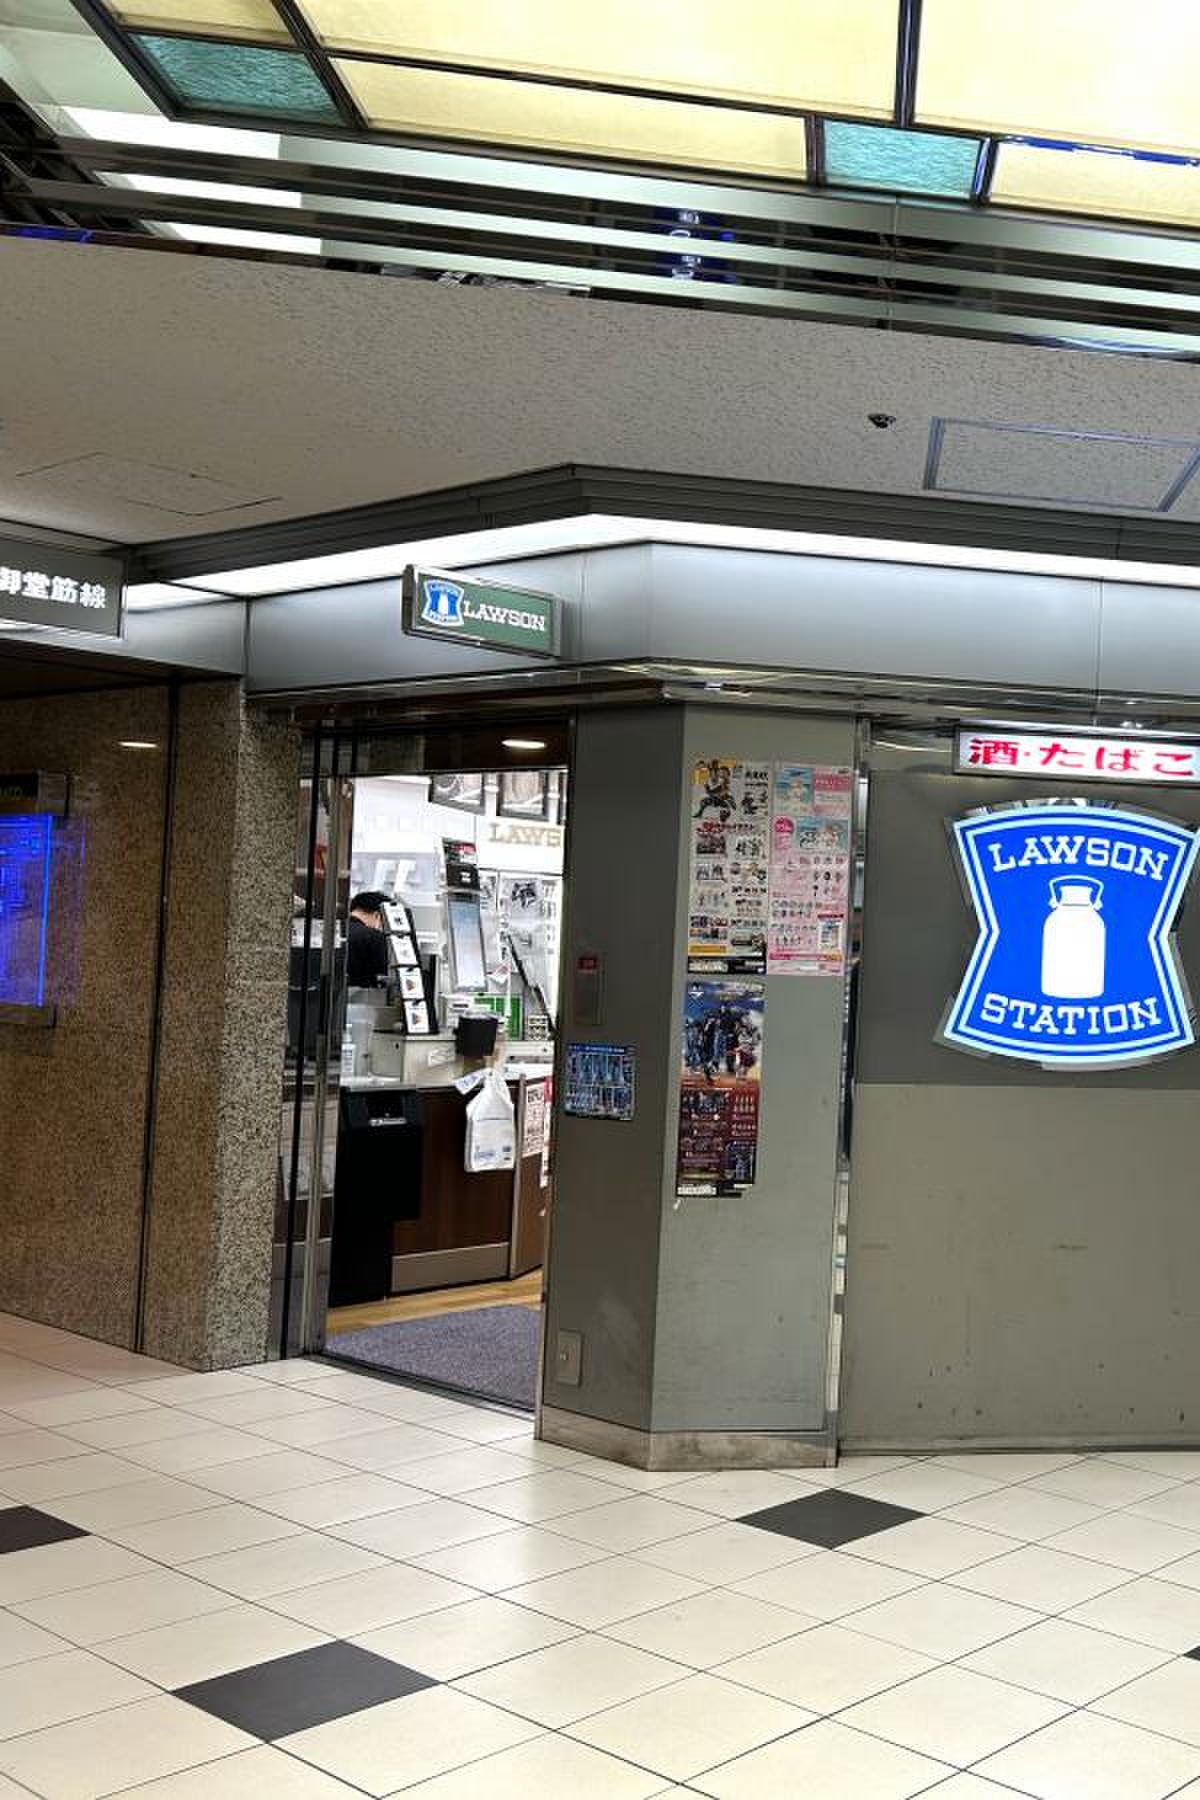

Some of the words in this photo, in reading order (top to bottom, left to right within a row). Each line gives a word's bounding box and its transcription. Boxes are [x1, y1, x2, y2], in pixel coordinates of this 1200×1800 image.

[463, 600, 546, 631] LAWSON
[987, 836, 1169, 881] LAWSON
[980, 993, 1161, 1035] STATION
